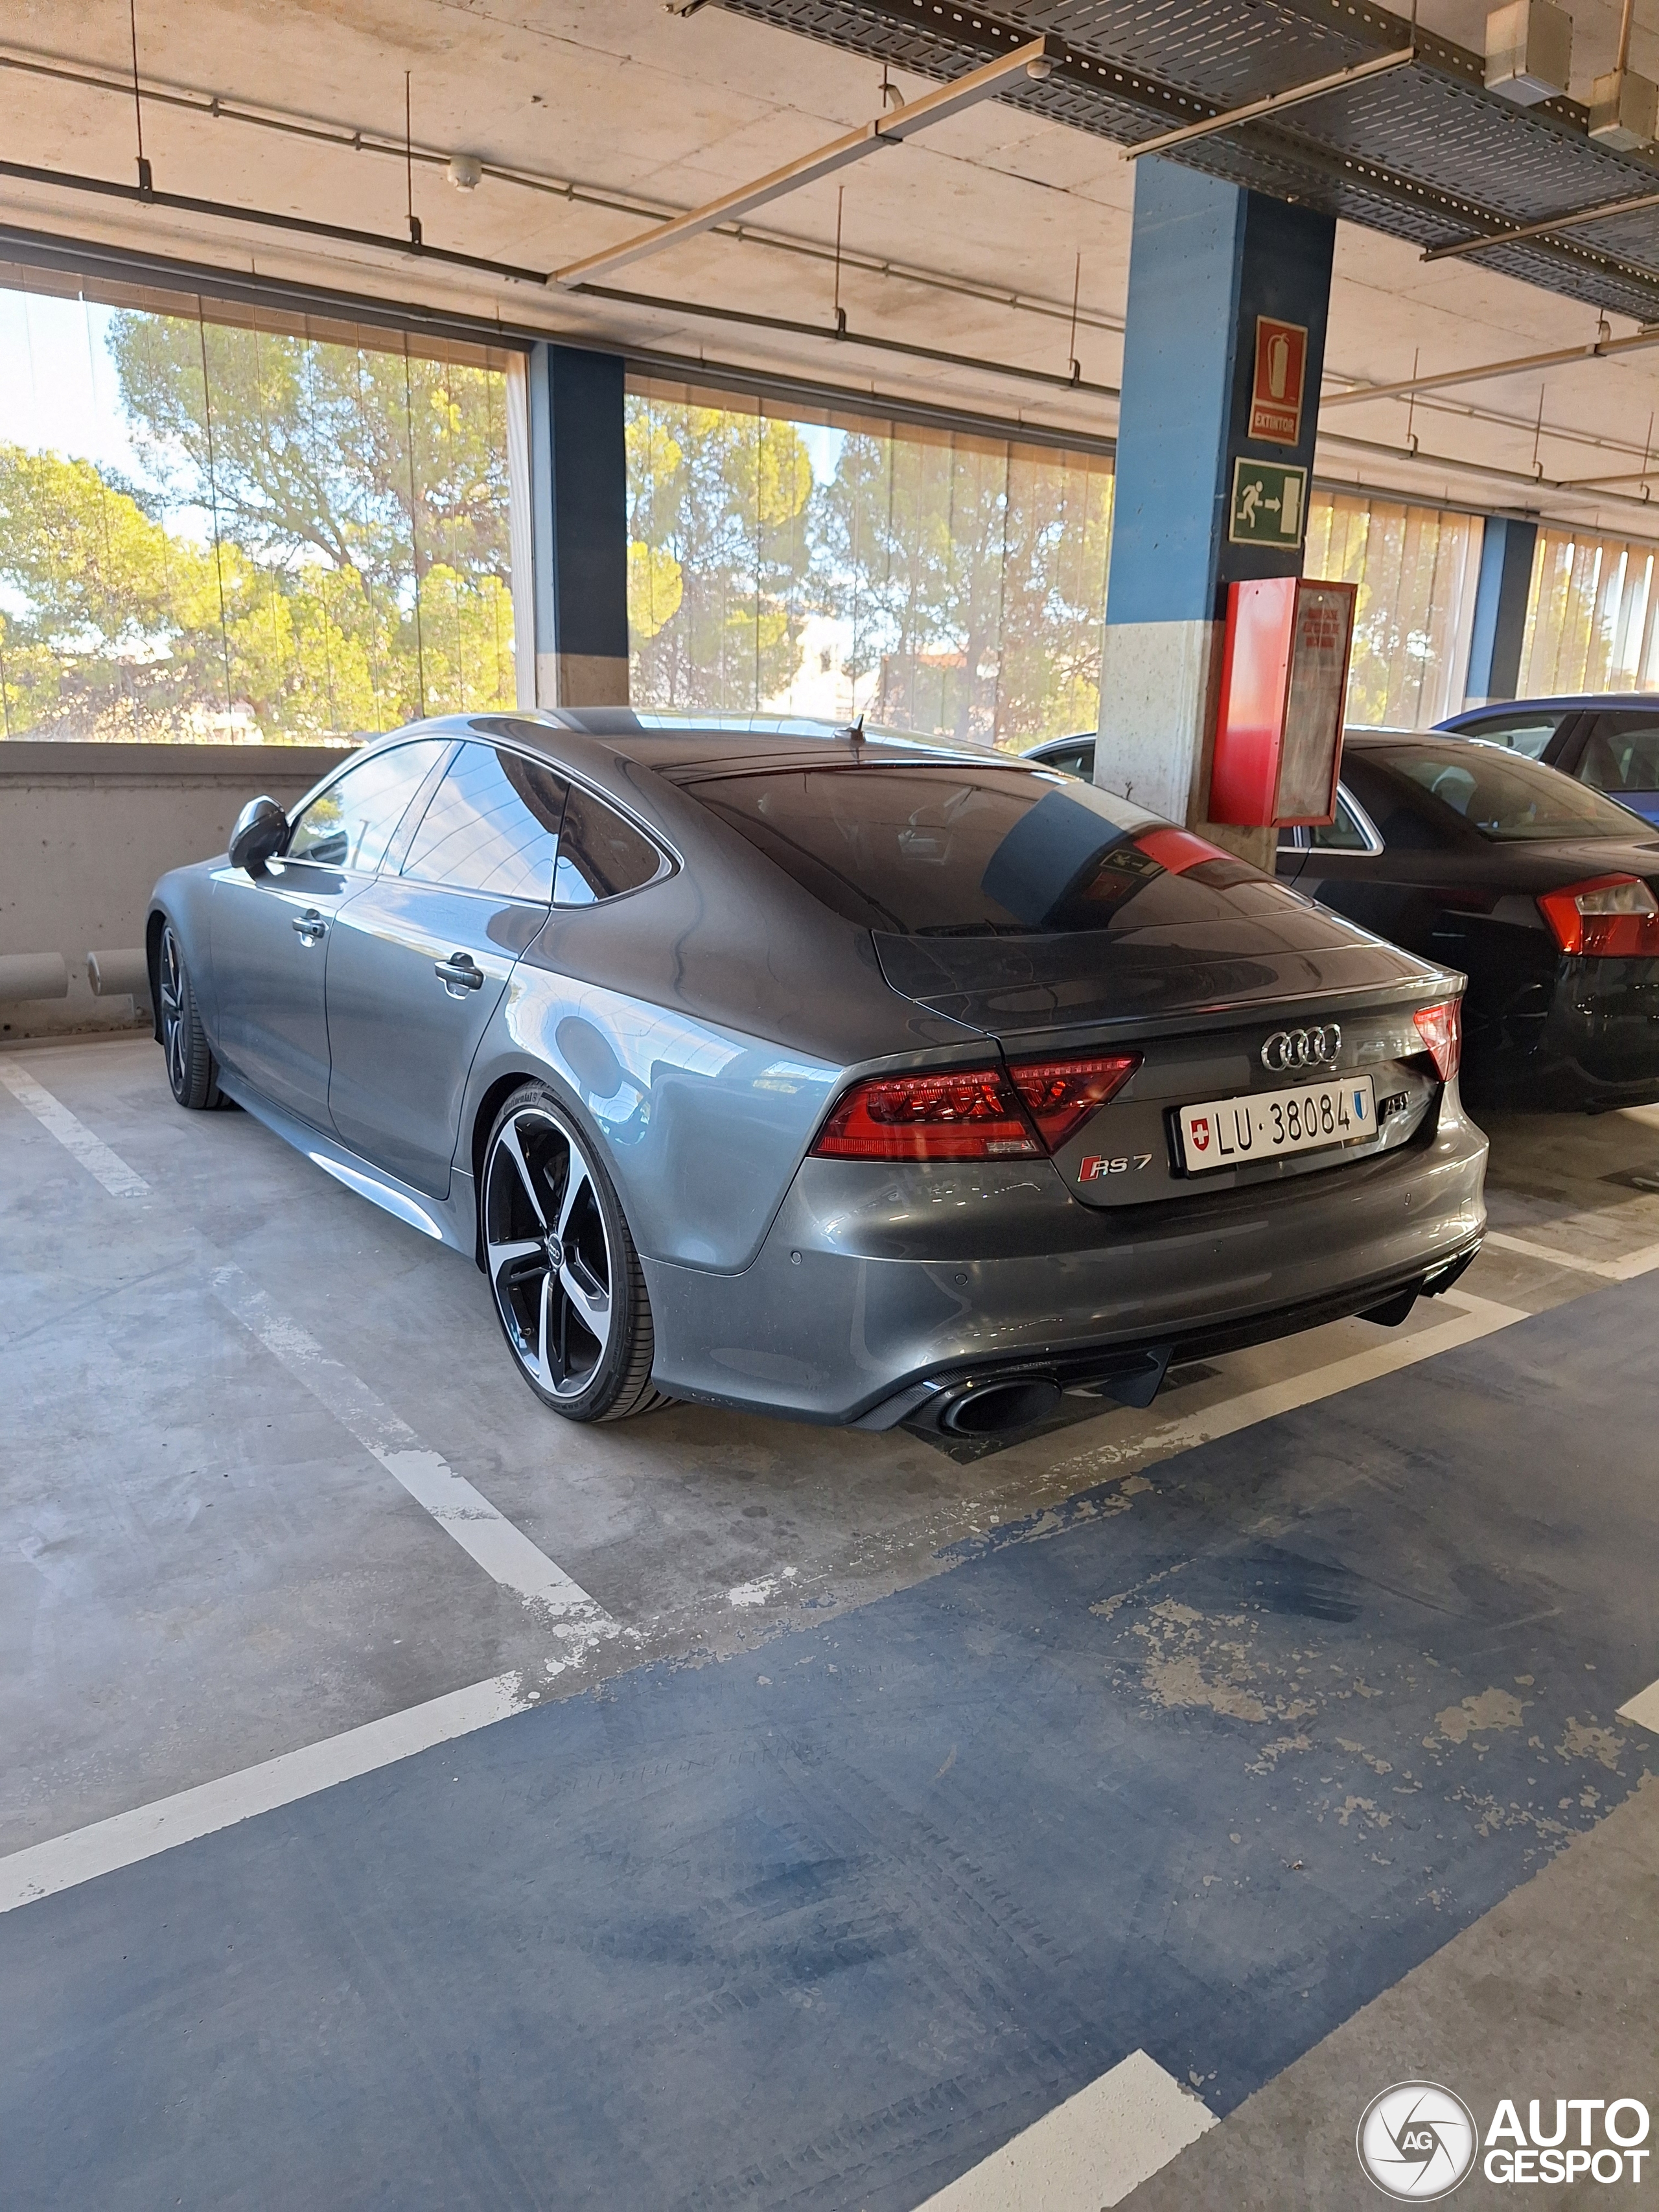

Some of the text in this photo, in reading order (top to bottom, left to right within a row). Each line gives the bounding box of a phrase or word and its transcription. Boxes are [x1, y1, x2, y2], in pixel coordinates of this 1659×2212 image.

[1254, 410, 1295, 434] EXTINTOR
[1088, 1153, 1153, 1178] RS 7
